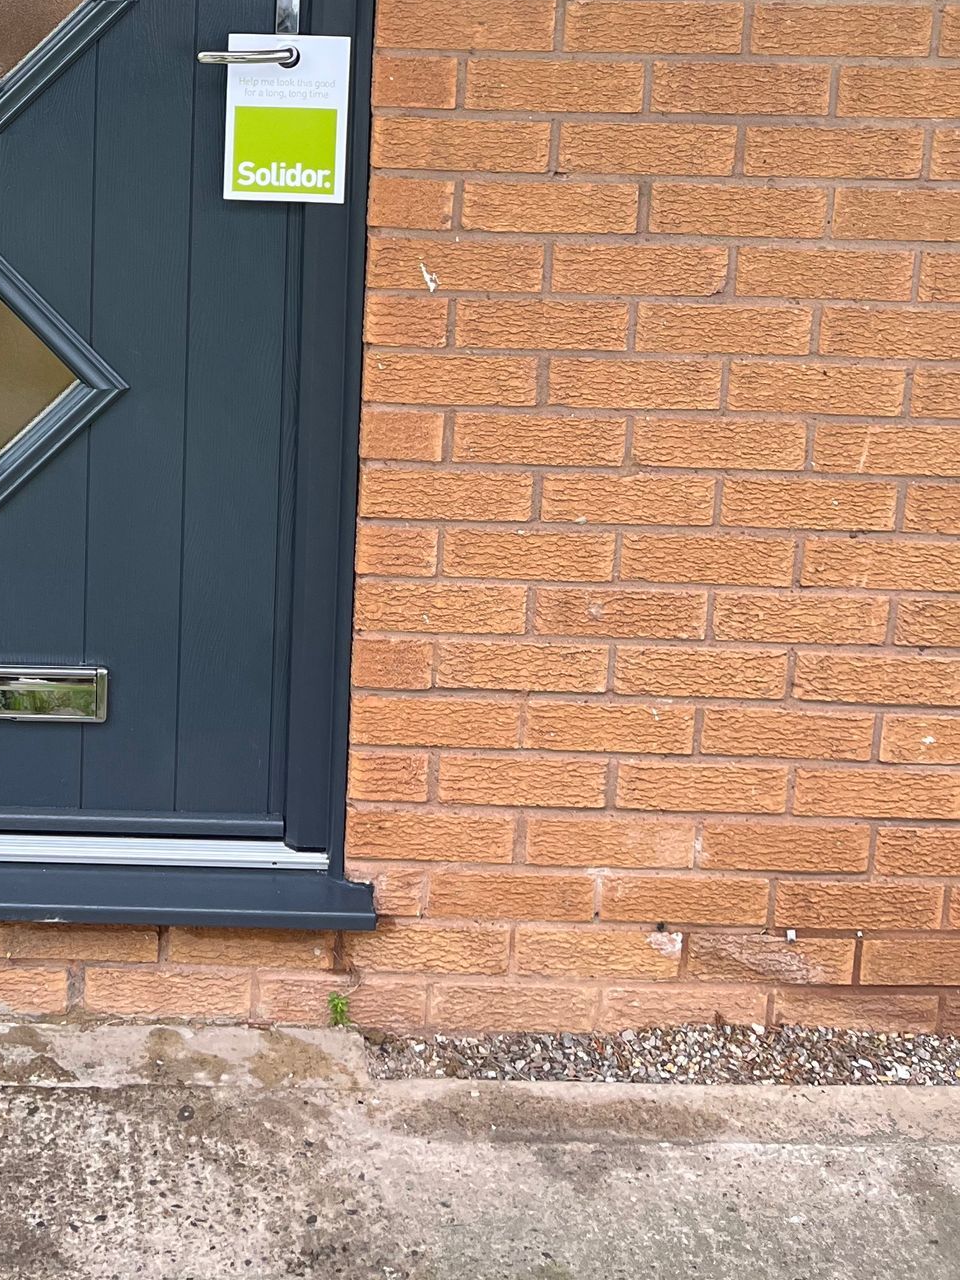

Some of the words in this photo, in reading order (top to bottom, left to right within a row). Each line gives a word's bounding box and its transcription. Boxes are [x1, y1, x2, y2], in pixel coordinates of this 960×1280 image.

[239, 77, 259, 87] Help
[277, 78, 295, 87] look
[297, 78, 313, 87] this
[314, 80, 336, 89] good
[244, 88, 257, 97] for
[265, 89, 287, 99] long,
[288, 89, 308, 100] long
[237, 161, 331, 189] Solidor.
